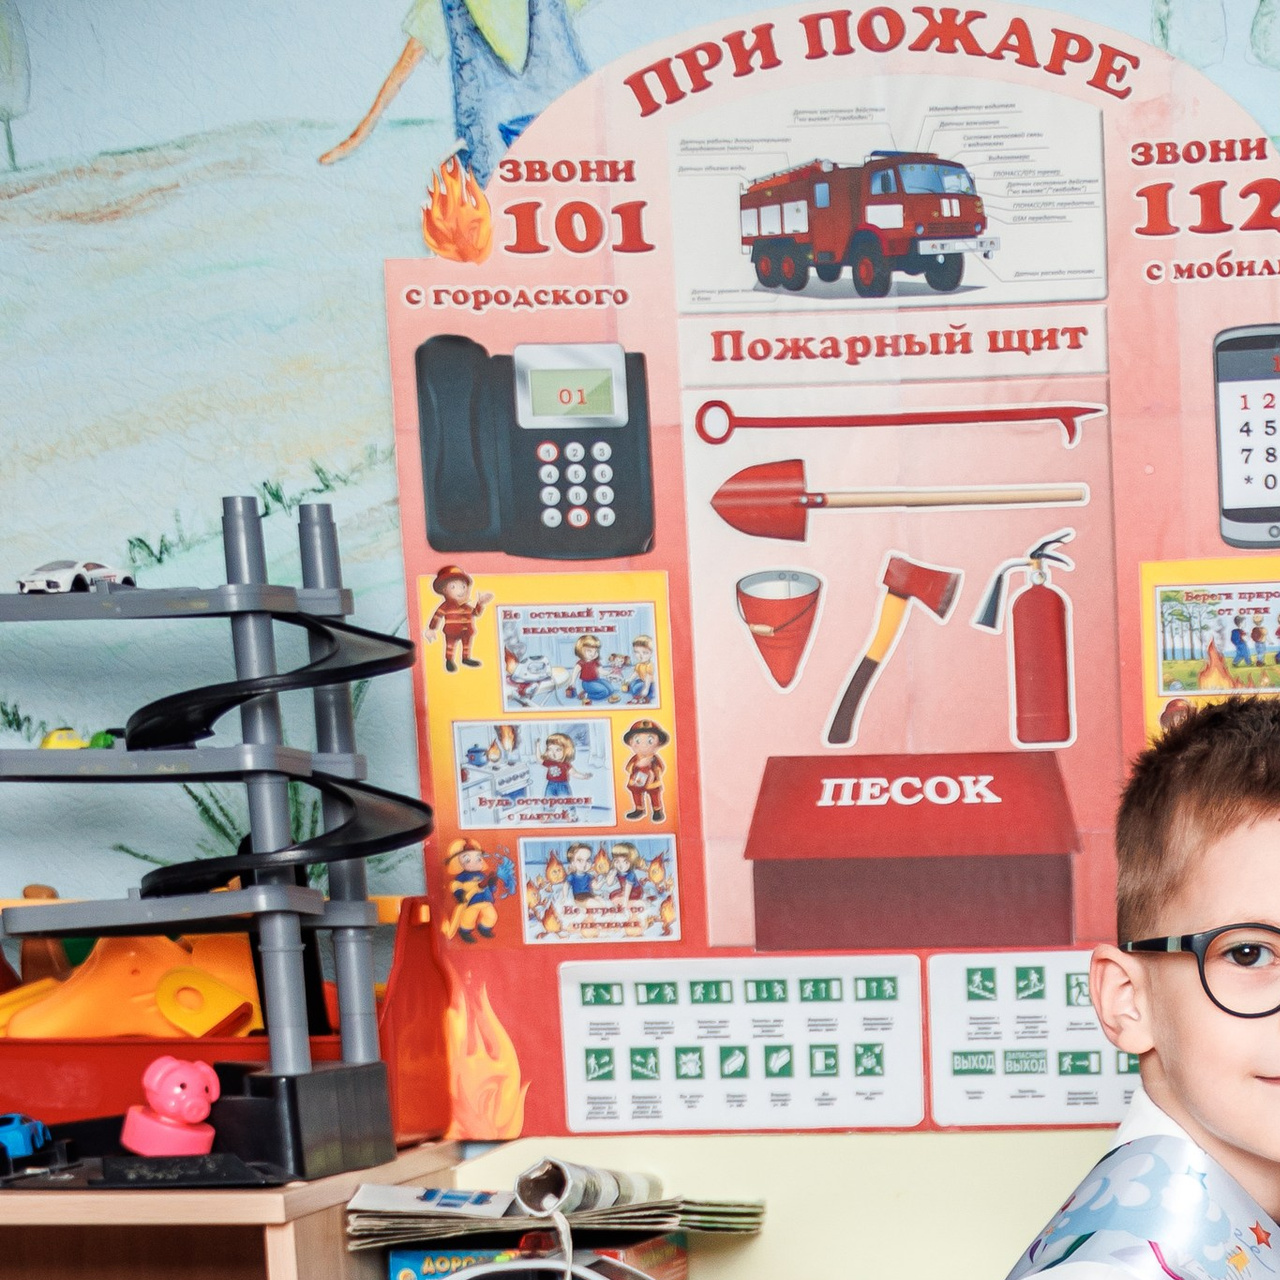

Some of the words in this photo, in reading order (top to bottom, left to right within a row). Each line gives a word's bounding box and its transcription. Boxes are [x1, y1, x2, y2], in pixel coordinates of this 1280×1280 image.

[624, 23, 781, 117] ПРИ
[800, 6, 1140, 99] ПОЖАРЕ
[503, 200, 656, 254] 101
[1146, 263, 1162, 281] с
[405, 288, 422, 305] с
[433, 288, 630, 311] городского
[711, 323, 972, 365] Пожарный
[988, 326, 1088, 356] щит
[558, 388, 588, 405] 01
[1240, 394, 1251, 411] 1
[1263, 392, 1276, 409] 2
[1239, 421, 1253, 437] 4
[1264, 420, 1277, 436] 5
[1240, 448, 1254, 464] 7
[1265, 447, 1277, 463] 8
[1264, 474, 1277, 490] 0
[1184, 591, 1233, 603] Береги
[598, 609, 635, 620] утюг
[1239, 605, 1271, 616] огня
[816, 775, 1002, 807] ПЕСОК
[954, 1055, 995, 1072] ВЫХОД
[1006, 1060, 1047, 1074] ВЫХОД
